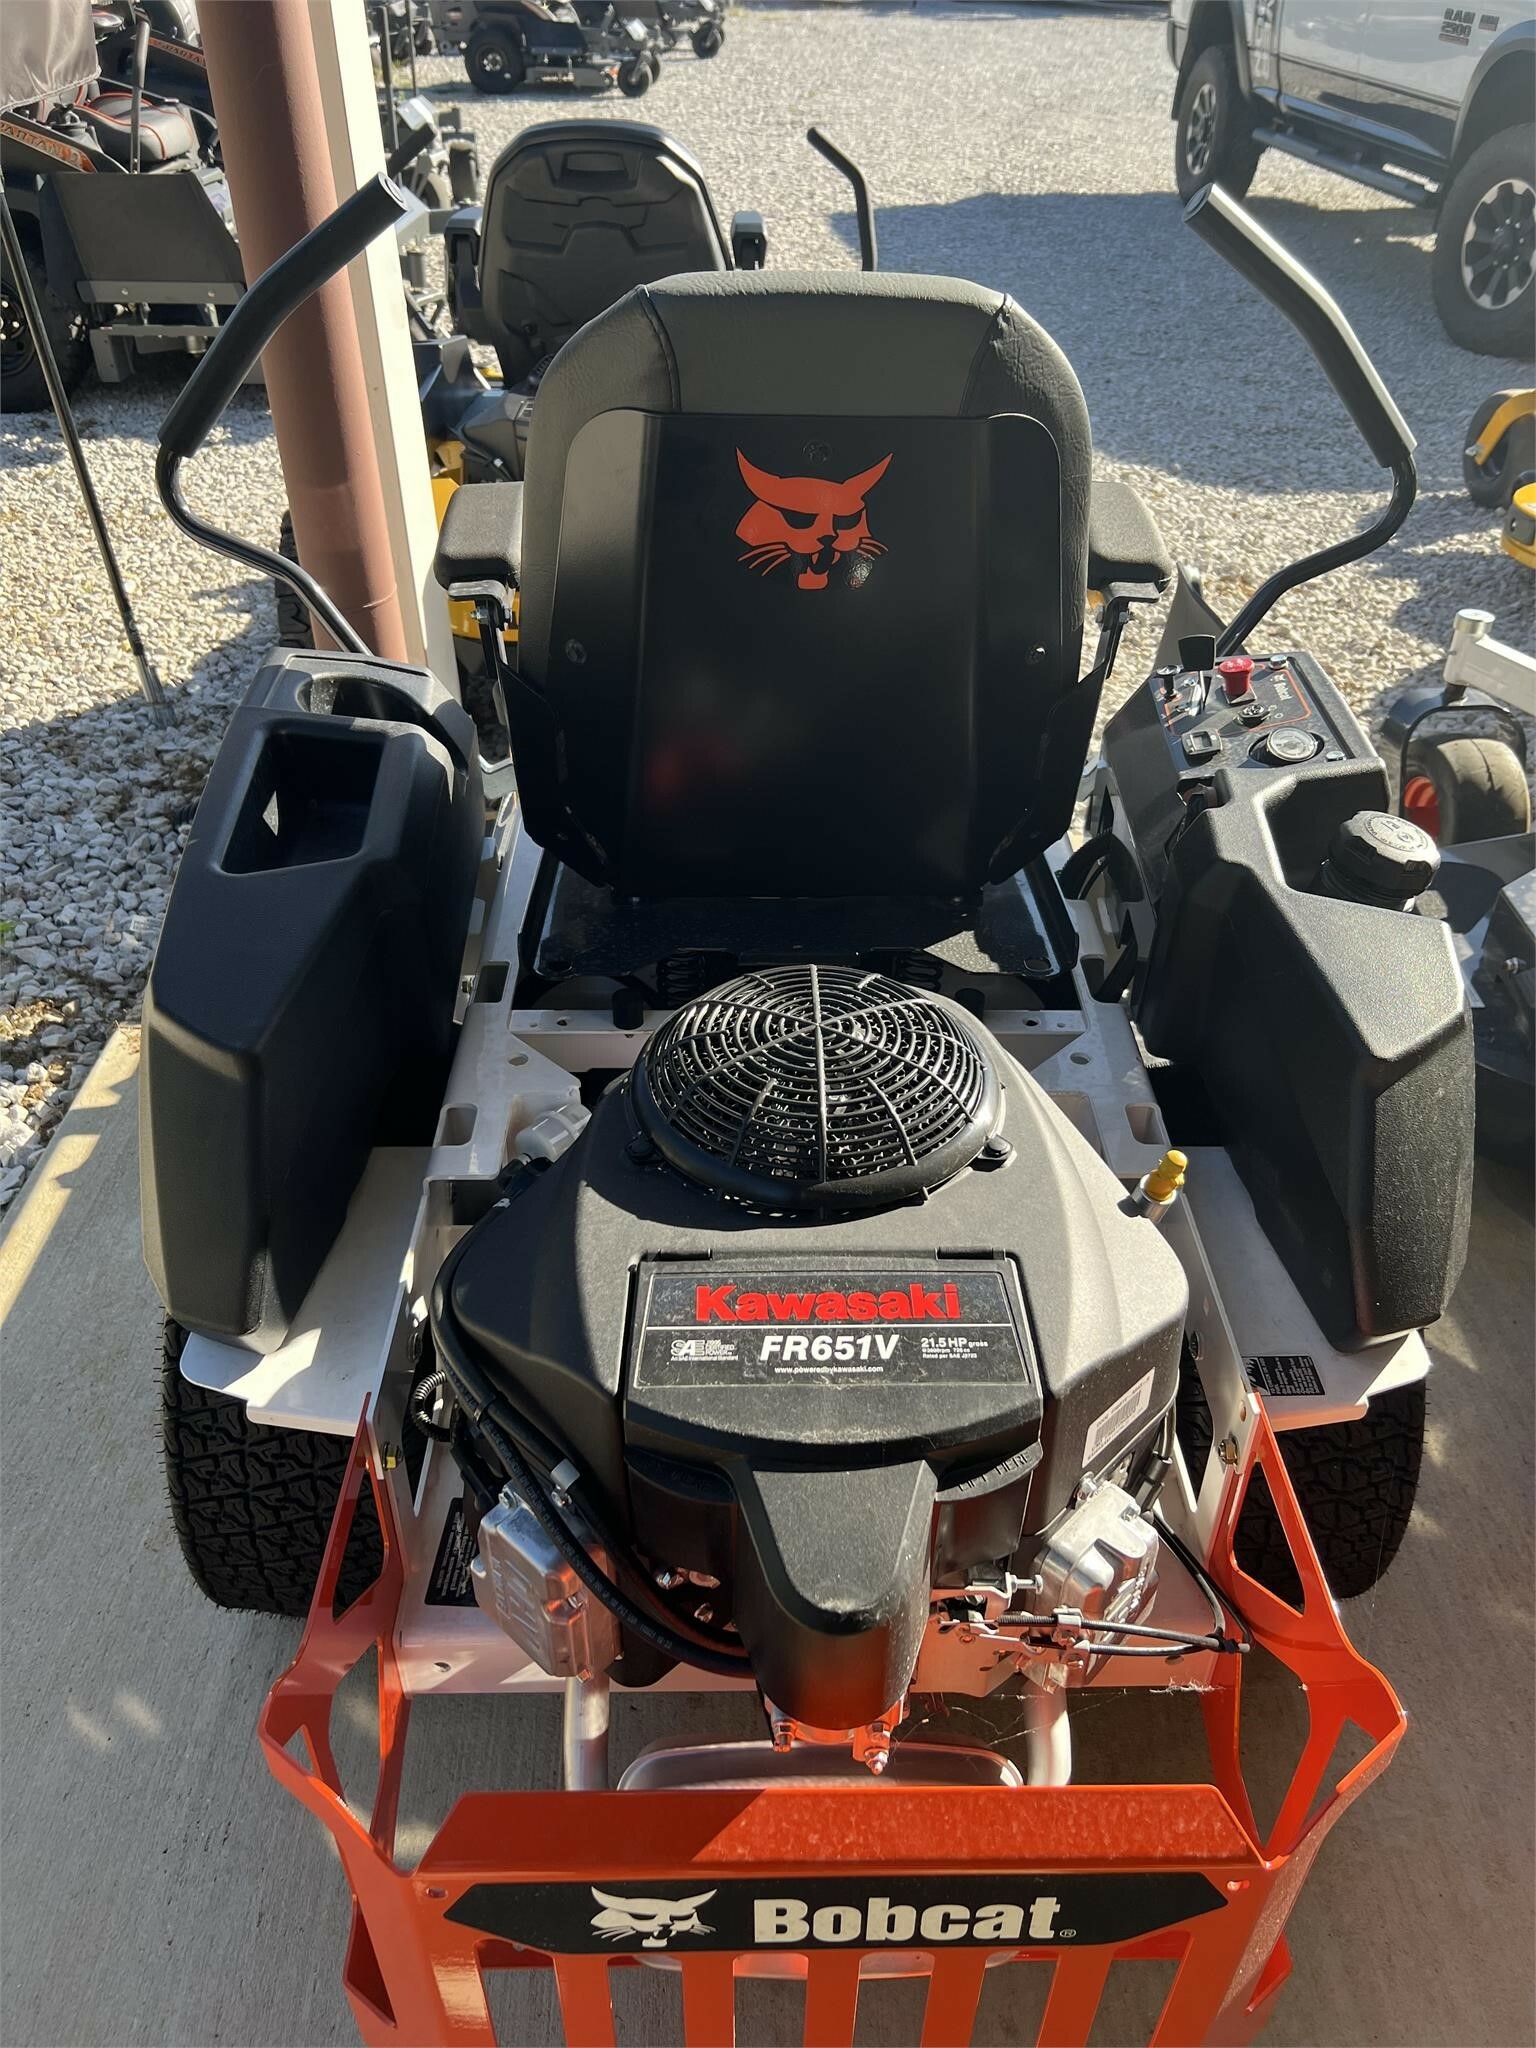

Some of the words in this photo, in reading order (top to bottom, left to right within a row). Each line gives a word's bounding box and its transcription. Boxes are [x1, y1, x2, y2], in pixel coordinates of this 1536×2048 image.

[694, 1283, 961, 1322] Kawasaki
[670, 1339, 705, 1356] SAE
[760, 1334, 900, 1361] FR651V
[920, 1337, 947, 1348] 21.5
[947, 1337, 967, 1348] HP
[774, 1365, 884, 1375] www.poweredbykawasaki.com
[754, 1897, 1060, 1943] Bobcat
